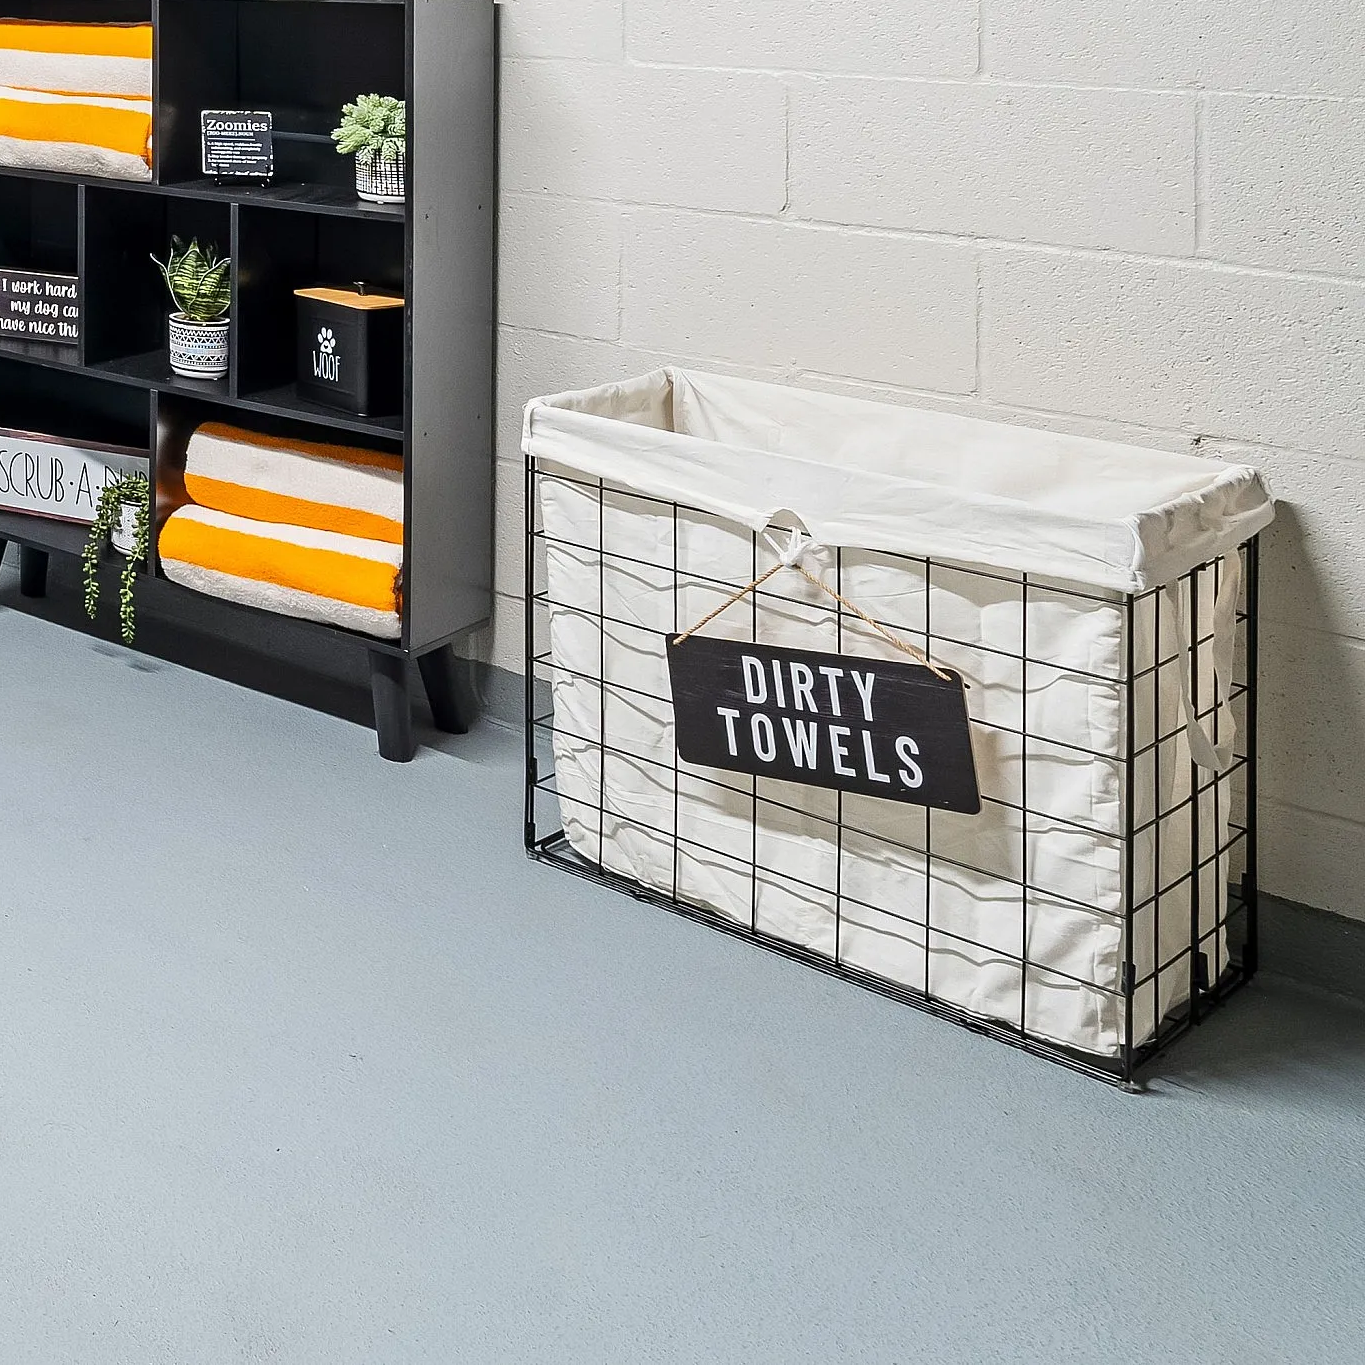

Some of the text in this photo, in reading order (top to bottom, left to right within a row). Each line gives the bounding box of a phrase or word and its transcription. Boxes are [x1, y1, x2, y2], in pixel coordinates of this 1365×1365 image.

[206, 119, 268, 132] Zoomies
[1, 278, 78, 299] I work hard
[10, 300, 31, 315] my
[34, 300, 59, 318] dog
[28, 320, 56, 335] nice
[312, 350, 341, 382] WOOF
[741, 655, 875, 722] DIRTY
[716, 706, 924, 788] TOWELS
